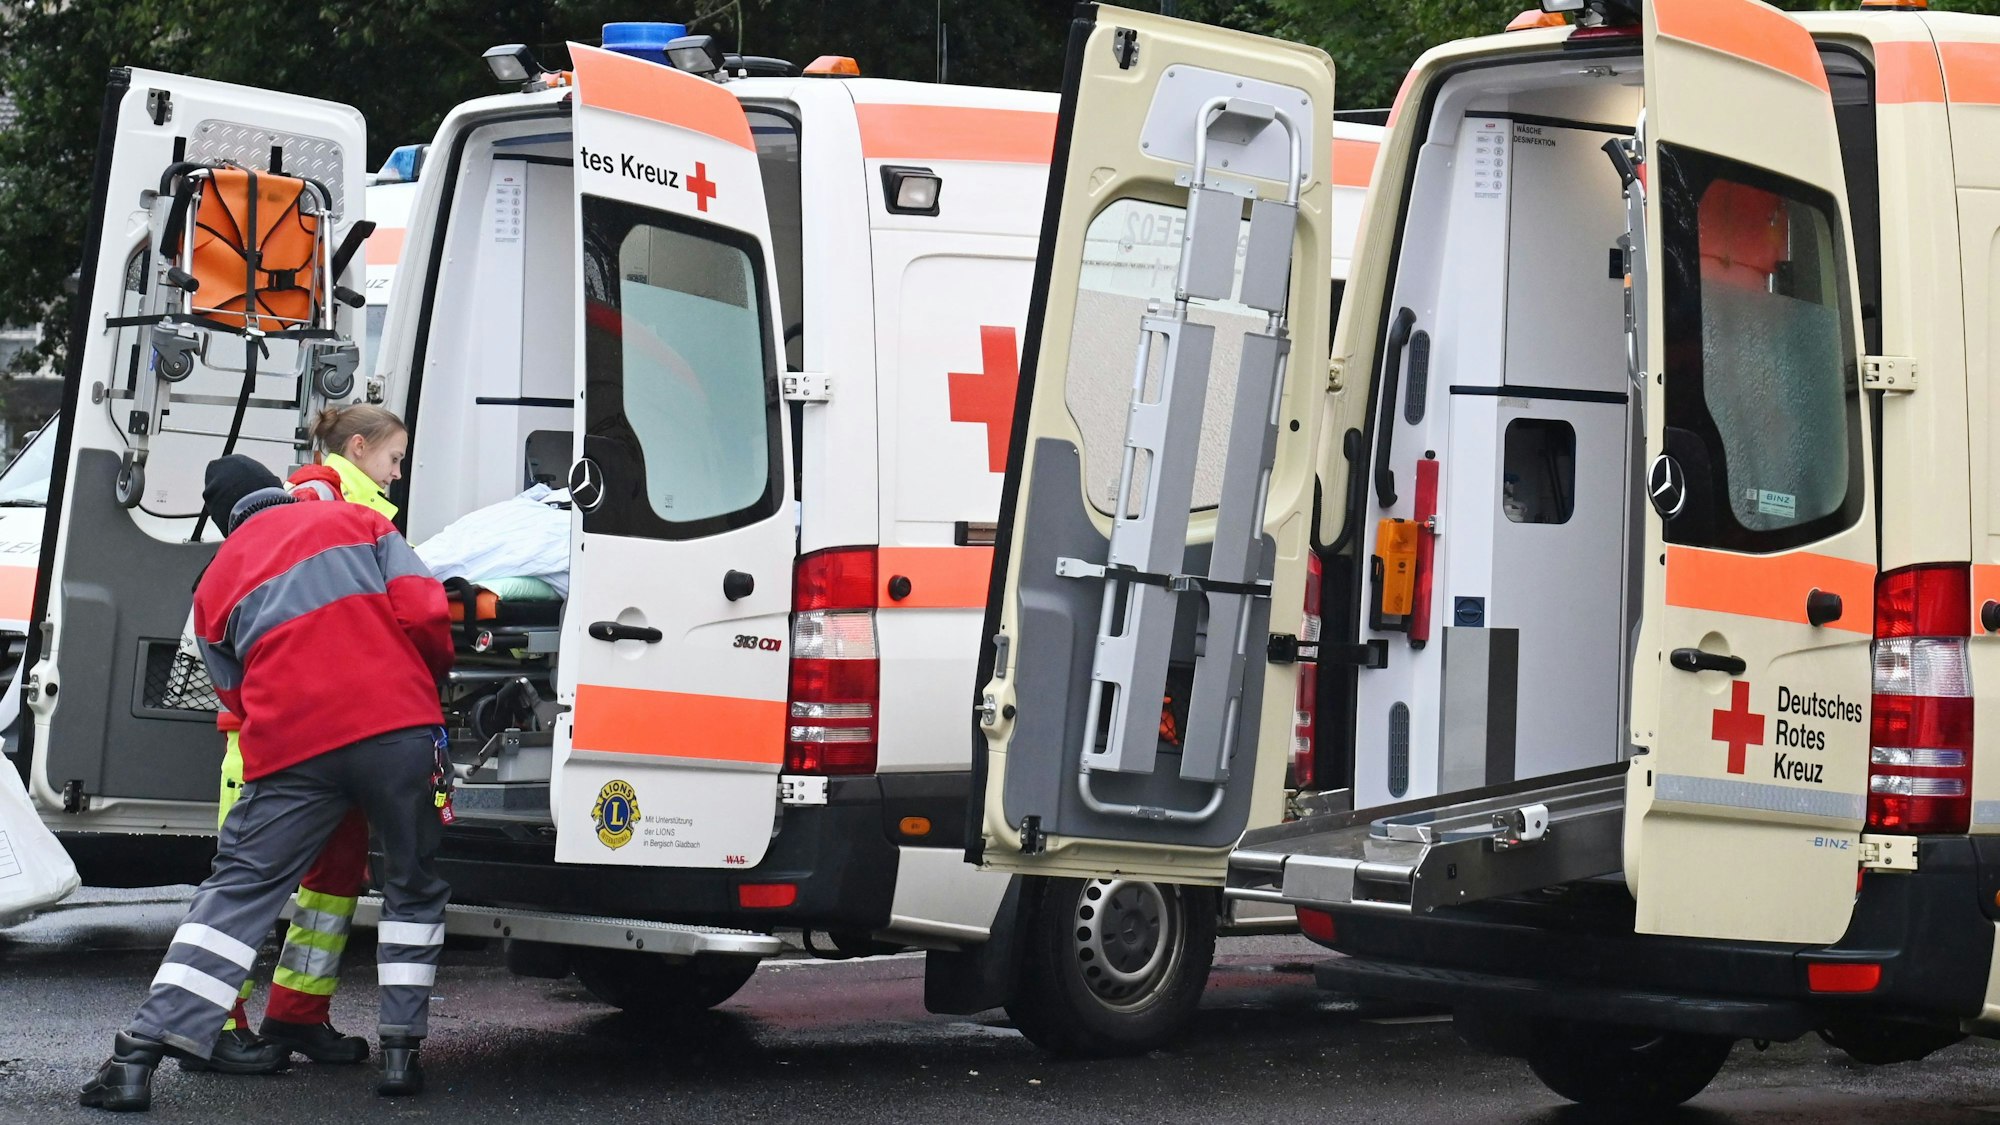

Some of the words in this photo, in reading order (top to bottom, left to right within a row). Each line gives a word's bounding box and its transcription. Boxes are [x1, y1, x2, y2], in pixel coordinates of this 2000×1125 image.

[1516, 125, 1542, 136] WÄSCHE
[1512, 135, 1556, 147] DESINFEKTION
[621, 153, 679, 189] Kreuz
[1766, 493, 1790, 504] BINZ
[733, 634, 759, 650] 313
[758, 637, 782, 652] CDI
[1777, 685, 1862, 724] Deutsches
[1776, 719, 1825, 751] Rotes
[1773, 752, 1824, 784] Kreuz
[603, 782, 633, 798] LIONS
[610, 801, 623, 826] L
[645, 815, 654, 823] Mit
[655, 815, 693, 827] Unterstützung
[644, 828, 654, 836] der
[655, 828, 675, 837] LIONS
[643, 839, 649, 847] in
[649, 838, 674, 849] Bergisch
[674, 839, 701, 849] Gladbach
[1814, 836, 1849, 850] BINZ
